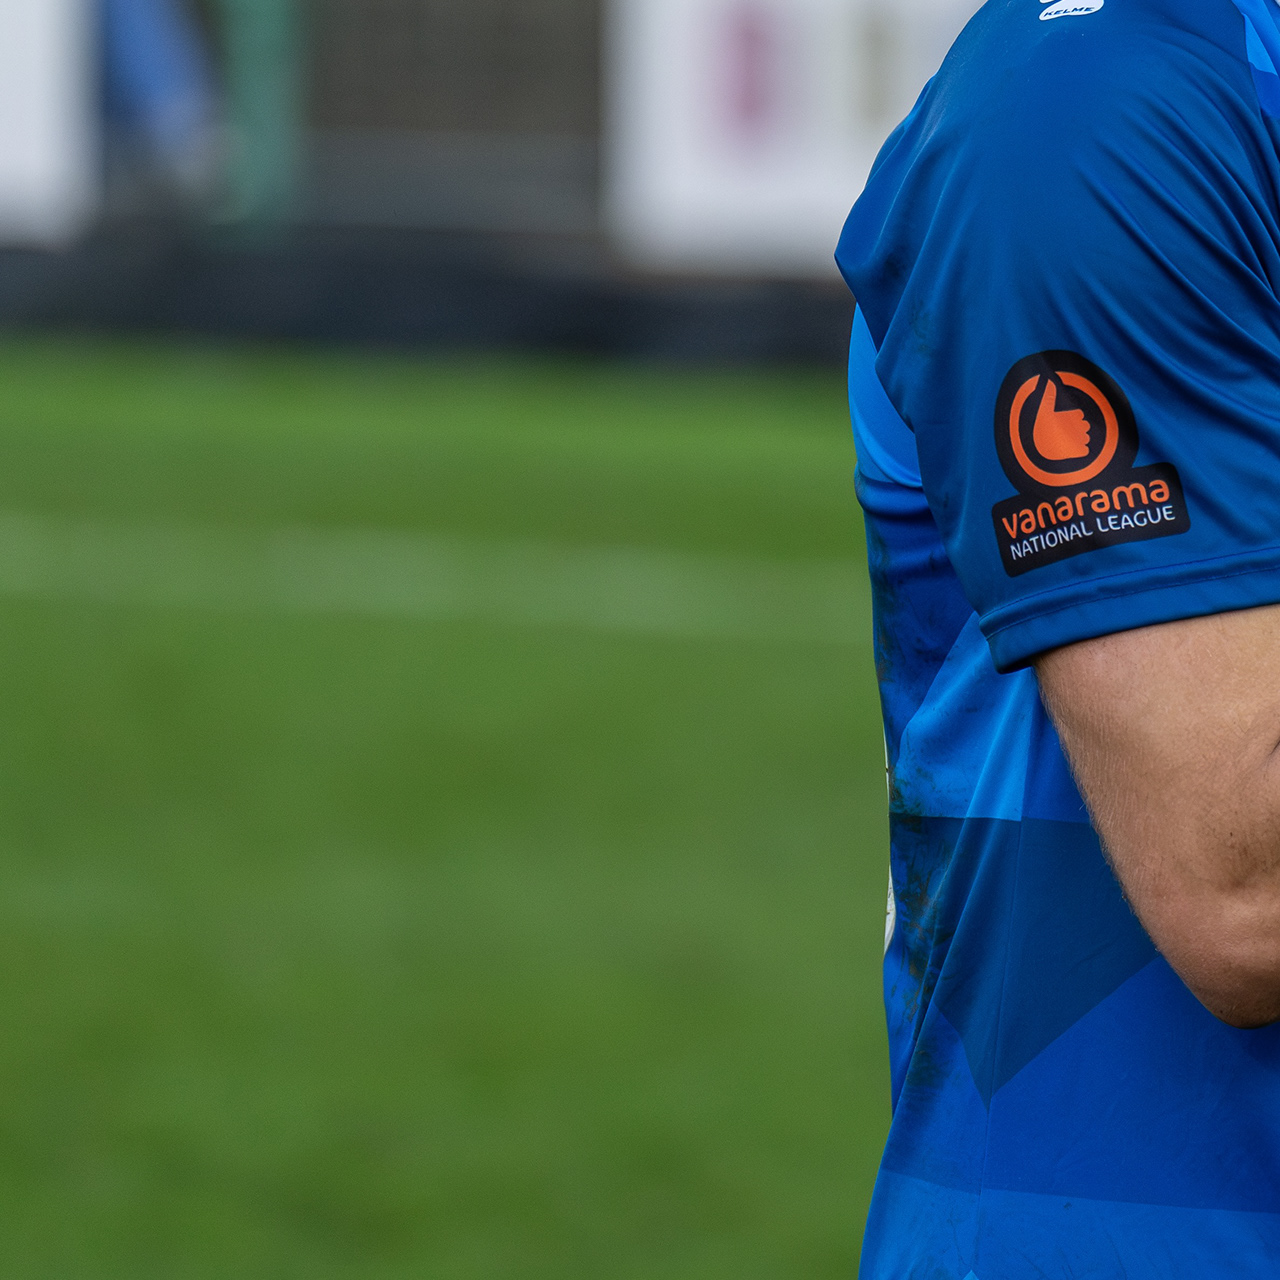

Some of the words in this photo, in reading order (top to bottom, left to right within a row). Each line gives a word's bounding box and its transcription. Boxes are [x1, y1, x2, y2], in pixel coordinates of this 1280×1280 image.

[1043, 6, 1095, 17] KELME
[1002, 479, 1170, 539] vanarama
[1010, 521, 1093, 560] NATIONAL
[1096, 505, 1176, 532] LEAGUE
